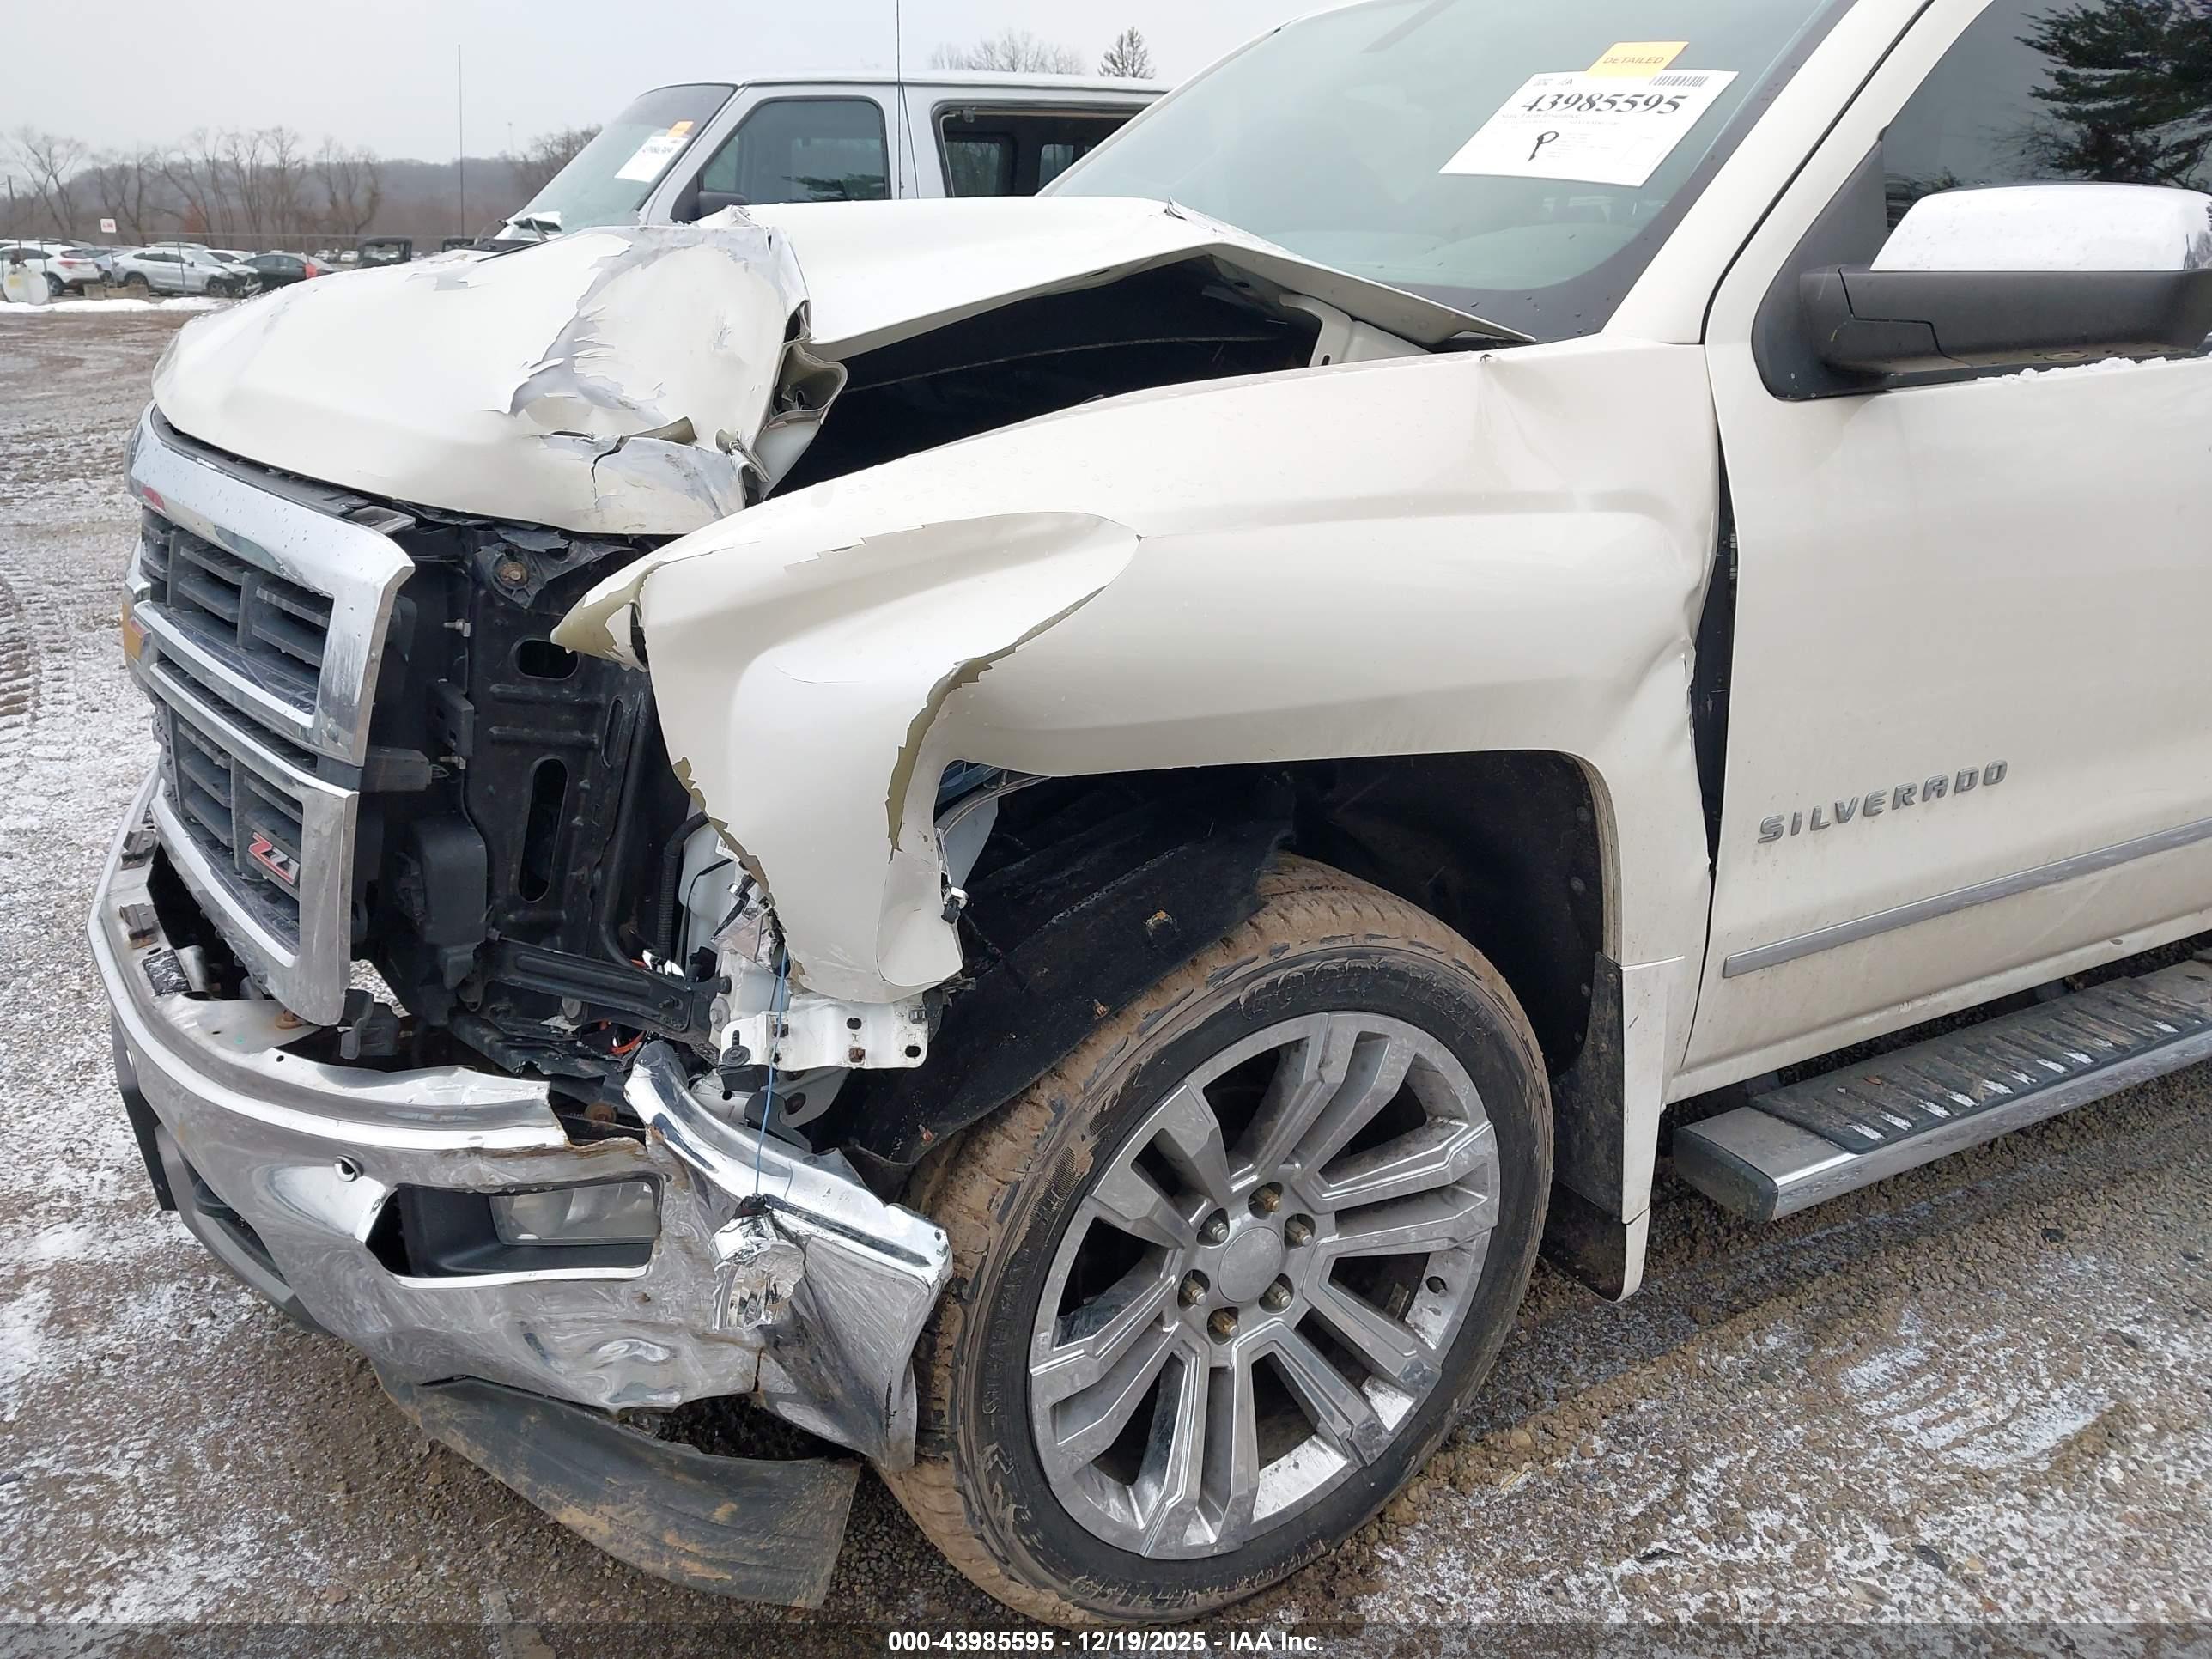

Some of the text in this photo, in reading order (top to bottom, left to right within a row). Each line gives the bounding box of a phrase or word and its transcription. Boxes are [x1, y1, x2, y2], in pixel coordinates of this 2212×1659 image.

[1602, 56, 1665, 64] DETAILED
[1521, 94, 1689, 113] 43985595
[1757, 759, 2008, 844] SILVERADO
[248, 831, 301, 885] Z71
